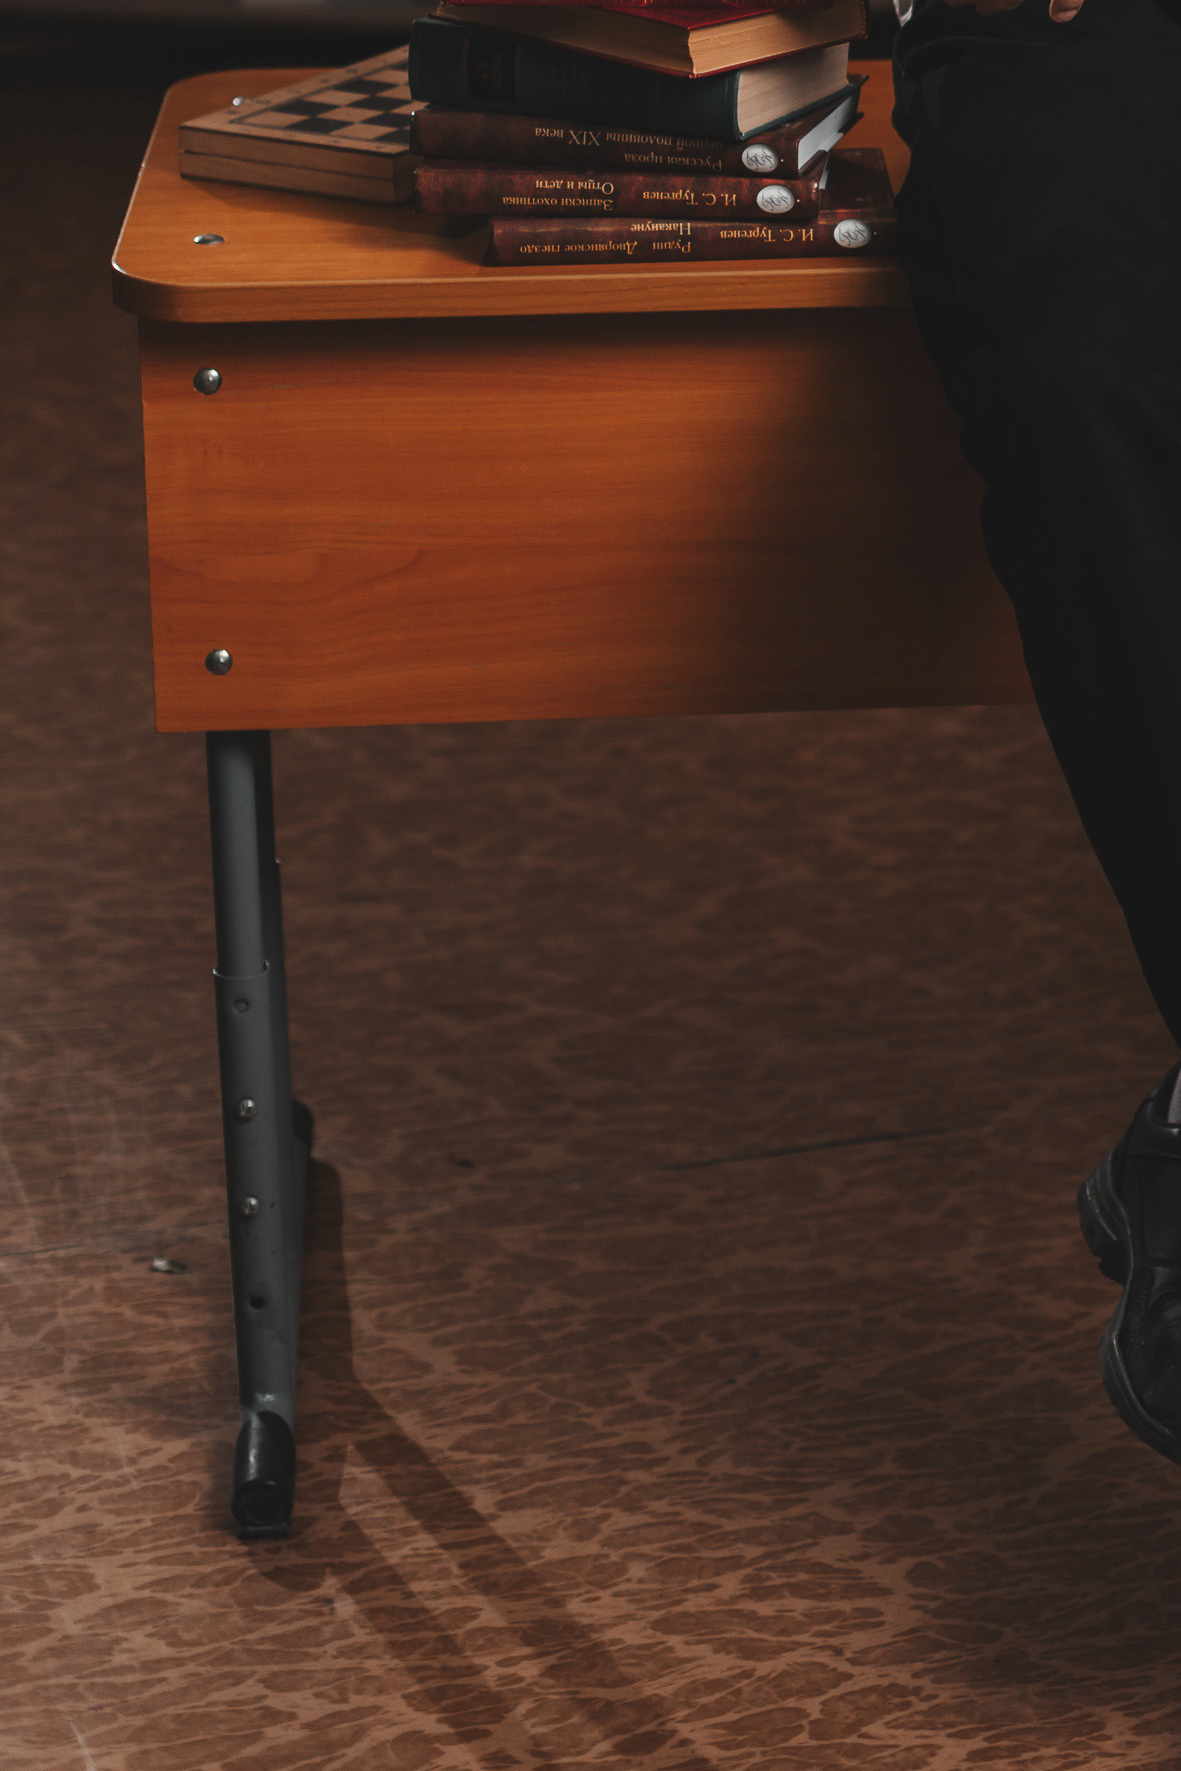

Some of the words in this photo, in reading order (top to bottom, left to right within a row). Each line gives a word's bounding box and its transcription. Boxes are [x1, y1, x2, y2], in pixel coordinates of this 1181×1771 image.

[534, 127, 564, 141] века
[567, 129, 602, 146] XIX
[605, 130, 673, 149] половины
[623, 151, 663, 166] проза
[666, 153, 723, 172] Русская
[534, 178, 564, 191] дети
[566, 180, 575, 191] и
[577, 179, 615, 195] Отцы
[501, 195, 558, 209] охотника
[560, 196, 614, 211] Записки
[642, 189, 696, 205] Тургенев
[702, 192, 717, 206] С.
[720, 192, 737, 206] И.
[629, 221, 692, 236] Накануне
[719, 225, 776, 242] Тургенев
[778, 228, 795, 242] С.
[797, 228, 814, 242] И.
[518, 244, 561, 256] гнездо
[564, 240, 638, 256] Дворянское
[651, 238, 692, 254] Рудин
